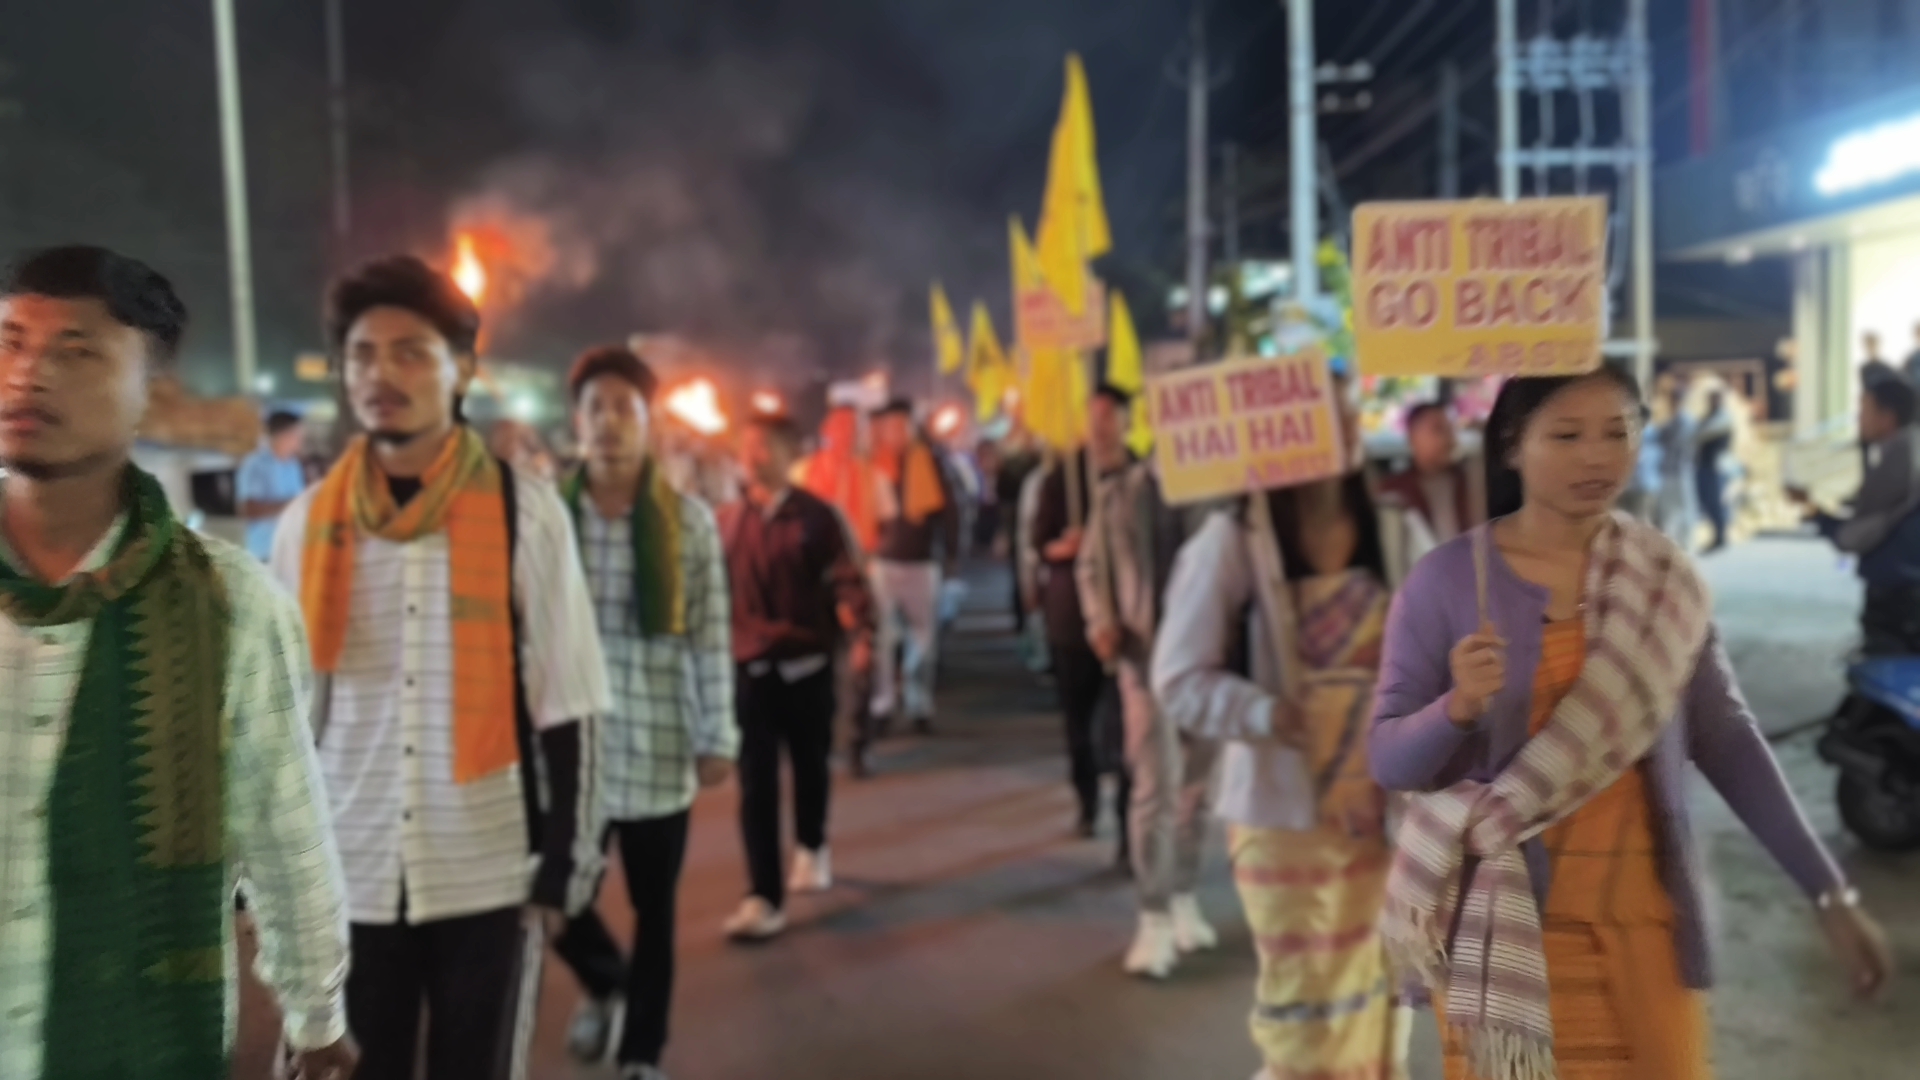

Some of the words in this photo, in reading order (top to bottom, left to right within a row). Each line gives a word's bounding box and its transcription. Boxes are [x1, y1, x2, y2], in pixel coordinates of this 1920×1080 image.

[1367, 279, 1440, 329] GO
[1454, 273, 1594, 328] BACK
[1174, 423, 1240, 465] HAI
[1248, 410, 1315, 453] HAI
